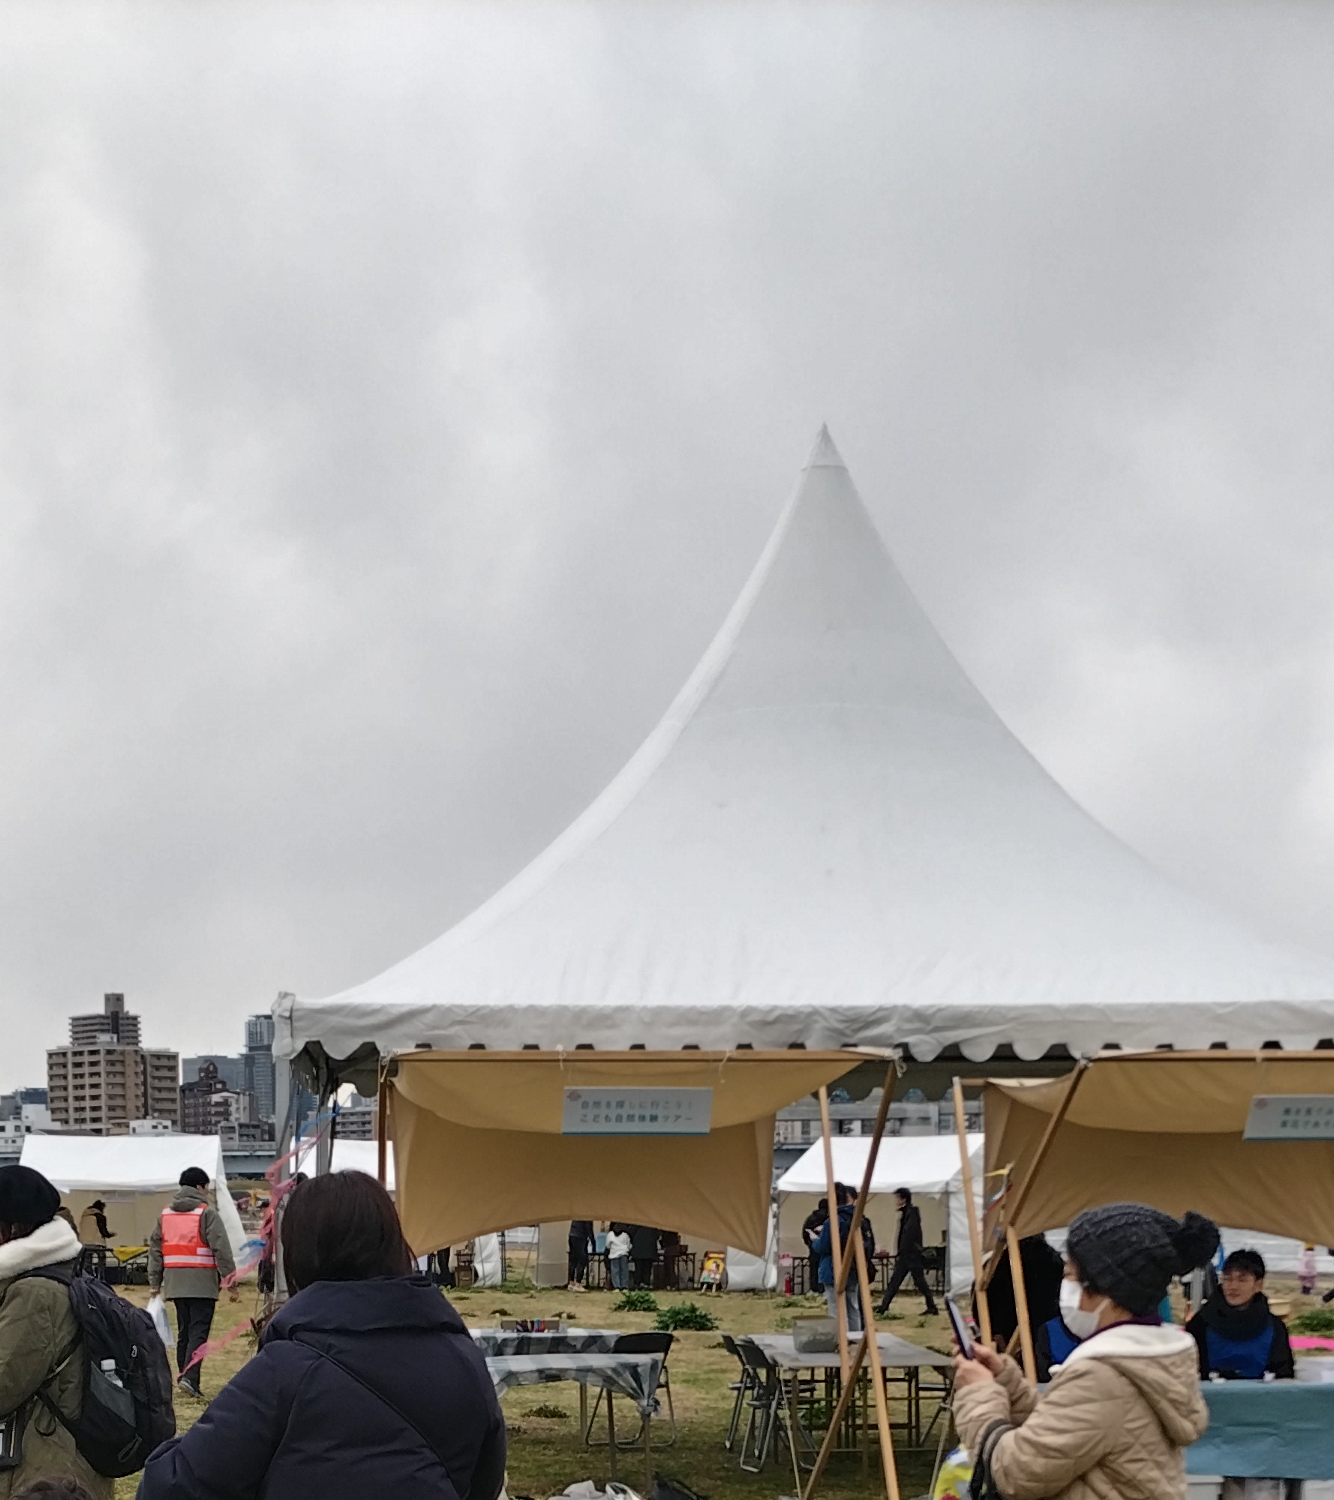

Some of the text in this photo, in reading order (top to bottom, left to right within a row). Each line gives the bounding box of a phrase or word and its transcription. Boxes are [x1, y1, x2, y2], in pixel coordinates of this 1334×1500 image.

[579, 1112, 694, 1124] こども自然体験ツアー
